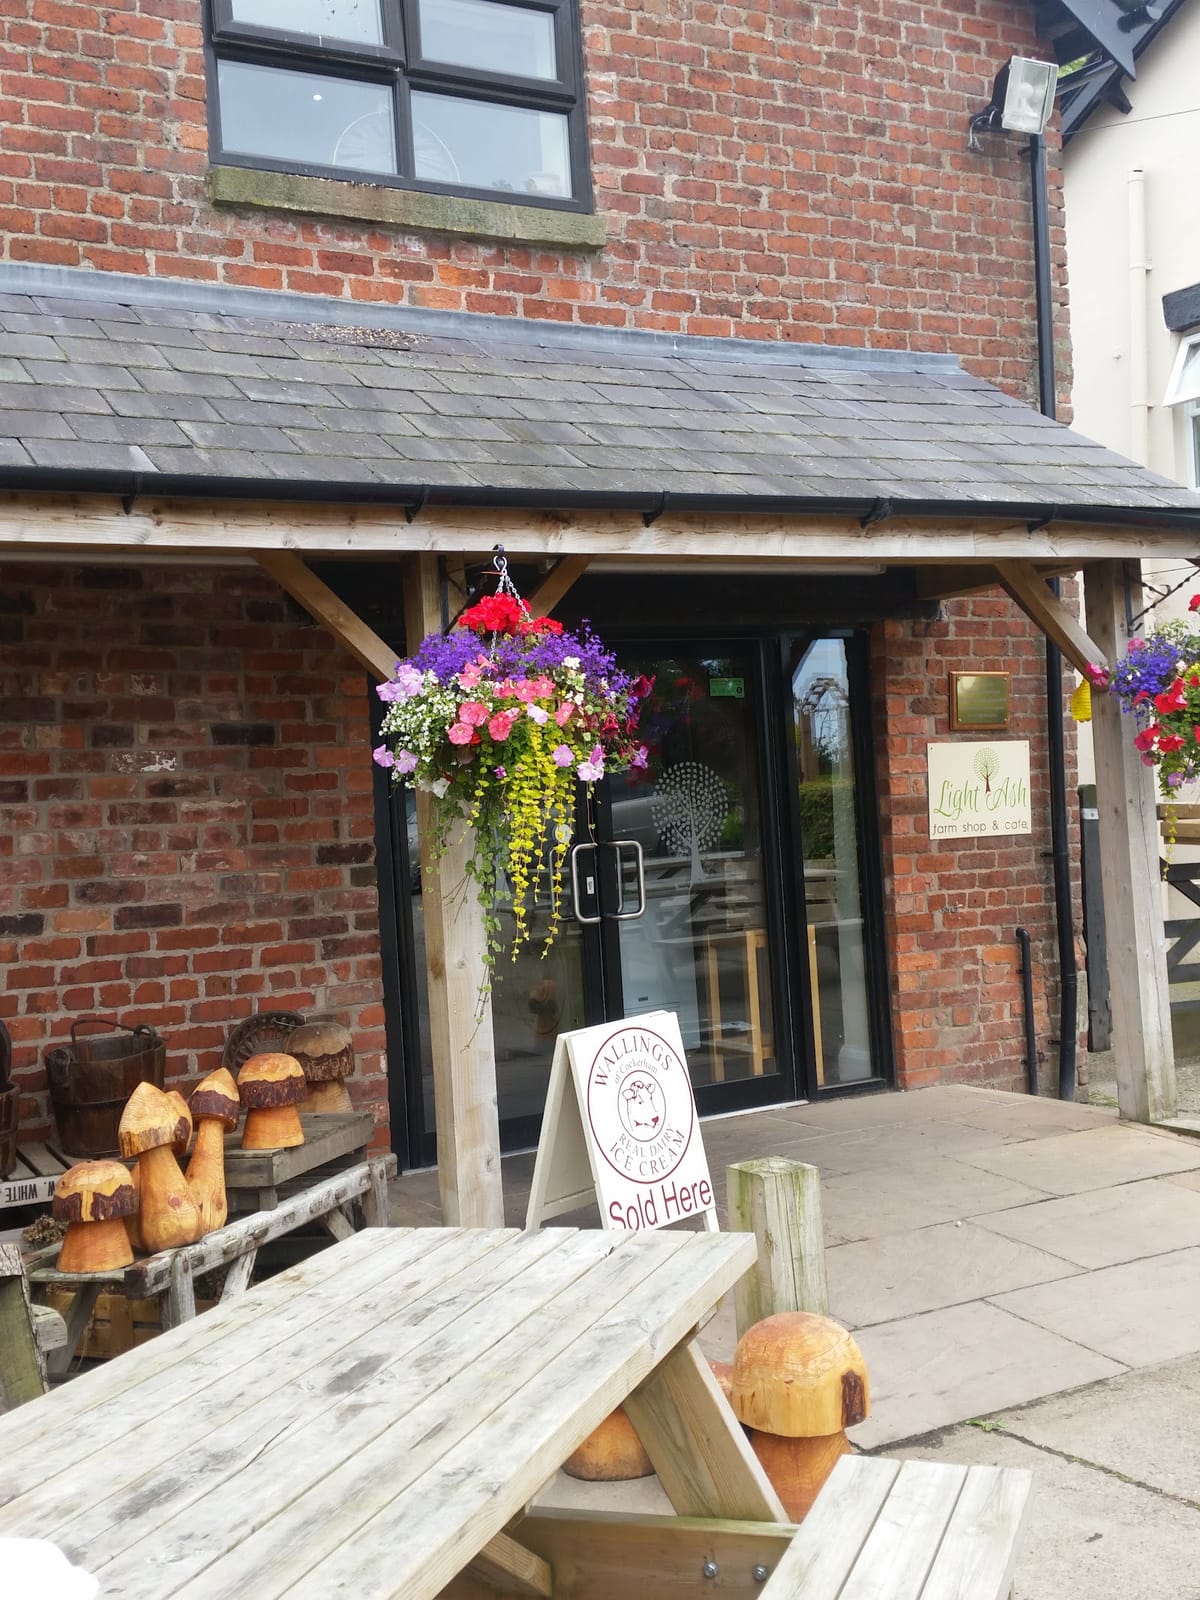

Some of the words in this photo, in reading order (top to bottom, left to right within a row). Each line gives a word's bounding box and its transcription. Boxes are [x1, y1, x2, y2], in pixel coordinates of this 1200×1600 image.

[933, 779, 980, 820] Light
[985, 777, 1027, 811] Ash
[932, 823, 957, 835] farm
[963, 822, 986, 832] shop
[992, 820, 999, 830] &
[595, 1035, 672, 1085] WALLINGS
[620, 1058, 658, 1075] Cockerham
[610, 1142, 634, 1171] ICE
[639, 1130, 685, 1176] CREAM
[619, 1133, 647, 1158] REAL
[649, 1125, 674, 1157] DAIRY
[5, 1183, 38, 1203] WHITE
[609, 1189, 658, 1231] Sold
[661, 1180, 712, 1219] Here
